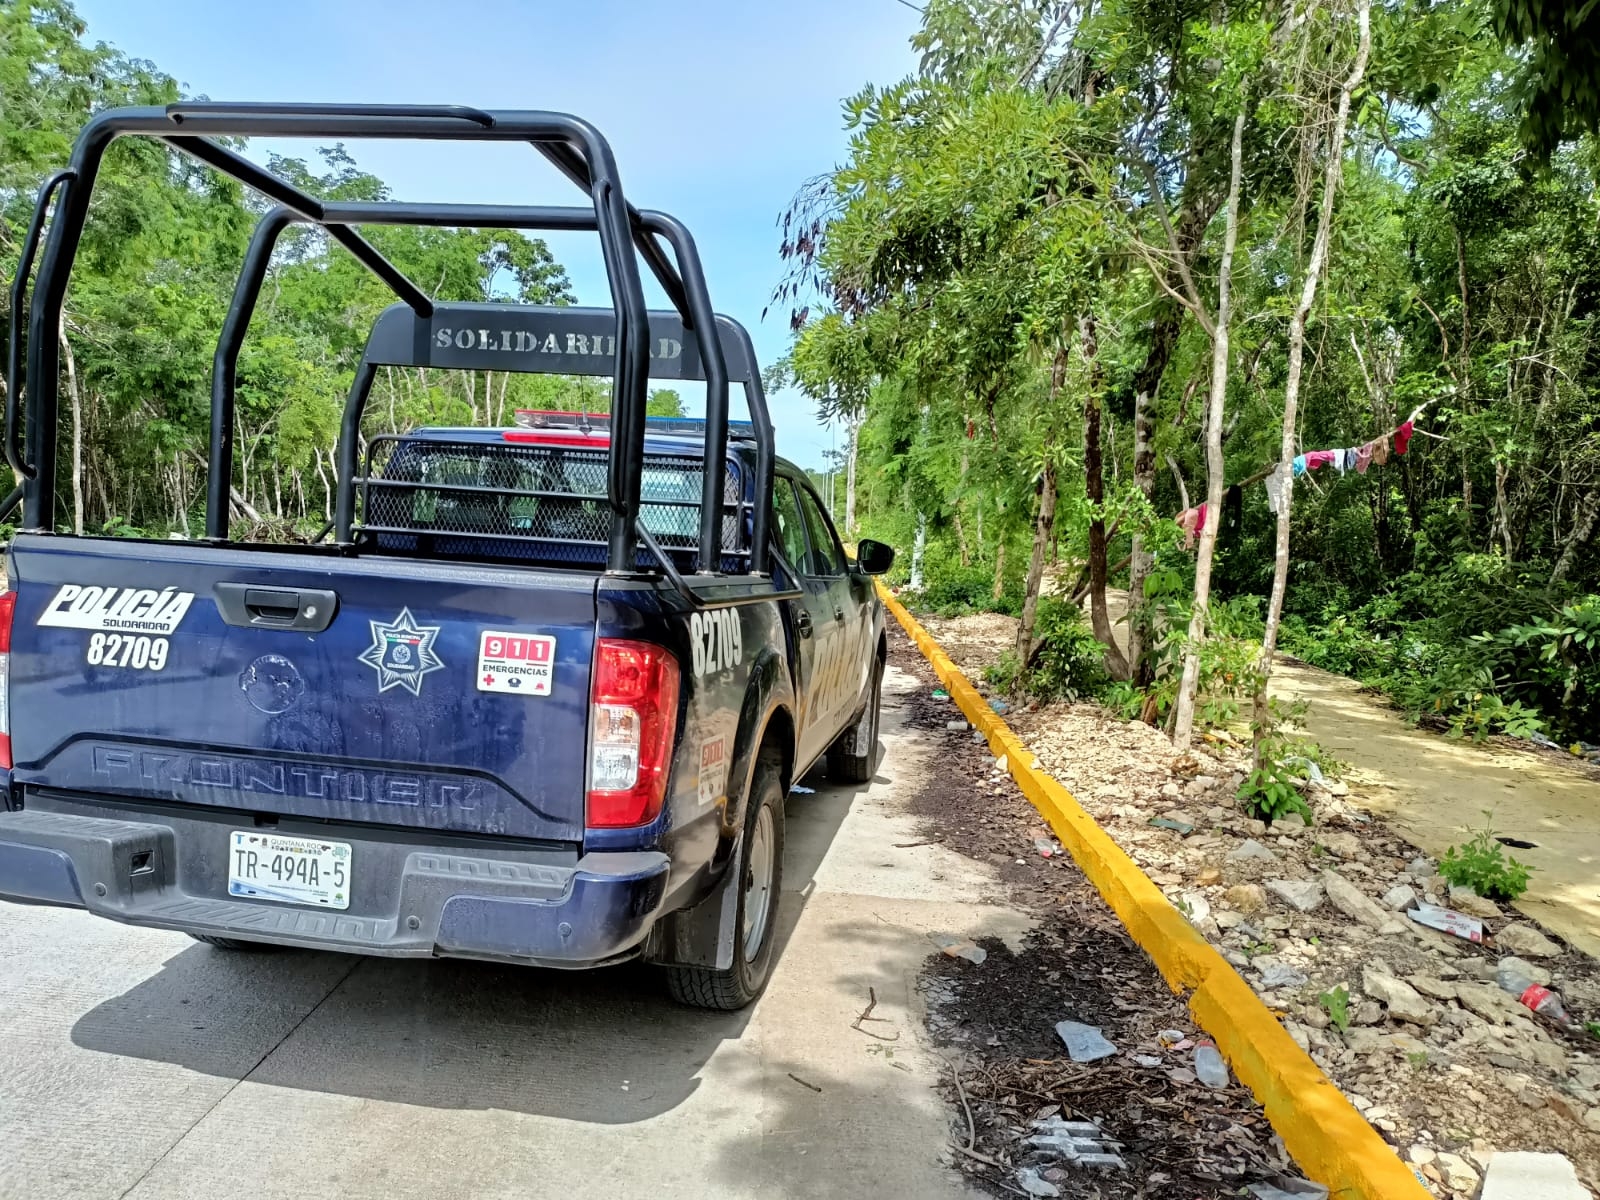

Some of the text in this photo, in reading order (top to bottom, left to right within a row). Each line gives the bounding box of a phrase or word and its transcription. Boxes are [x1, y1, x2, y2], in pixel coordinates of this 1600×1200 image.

[436, 328, 682, 359] SOLIDARID
[44, 584, 195, 622] POLICÍA
[102, 618, 171, 631] SOLIDARIDAD
[87, 633, 169, 670] 82709
[489, 640, 544, 659] 911
[690, 607, 743, 679] 82709
[482, 665, 548, 676] EMERGENCIAS
[92, 746, 482, 810] FRONTIER
[271, 839, 305, 848] QUINTANA
[235, 849, 345, 888] TR-494A-5
